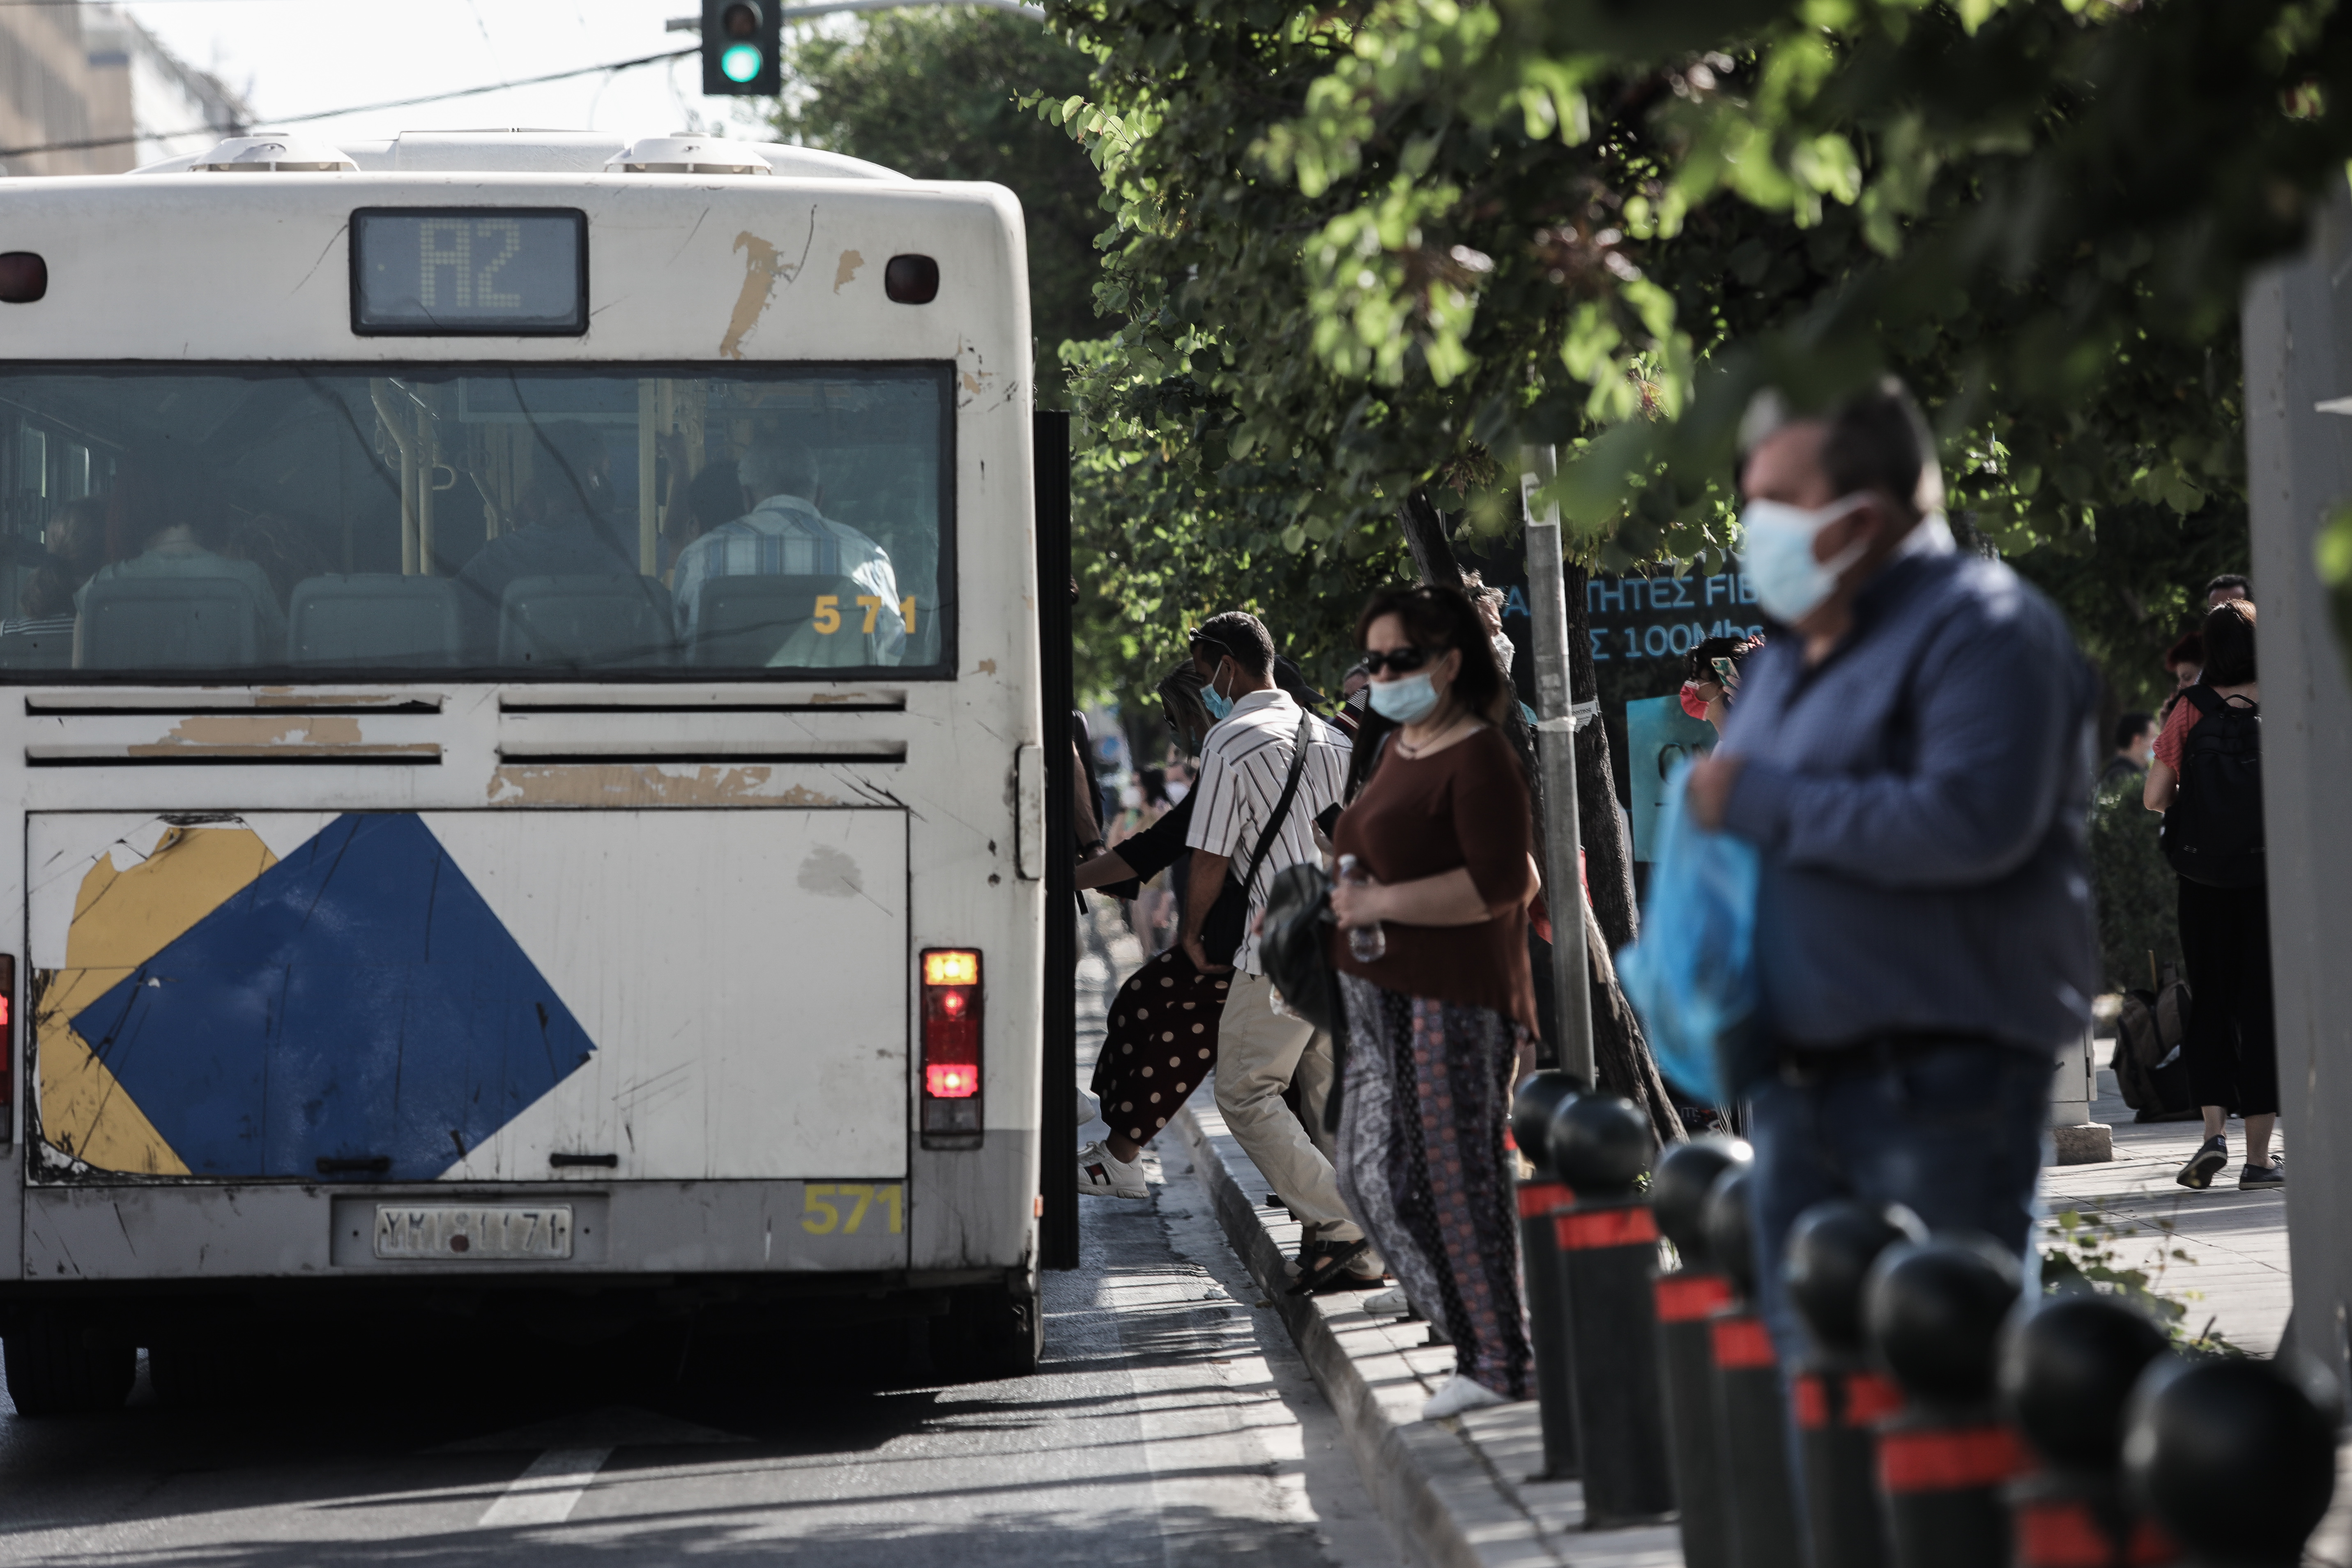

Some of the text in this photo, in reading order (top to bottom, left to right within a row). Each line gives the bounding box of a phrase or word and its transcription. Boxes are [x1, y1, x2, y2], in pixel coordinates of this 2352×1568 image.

[1705, 573, 1758, 607] FIB
[812, 595, 916, 634] 571
[801, 1184, 902, 1235] 571
